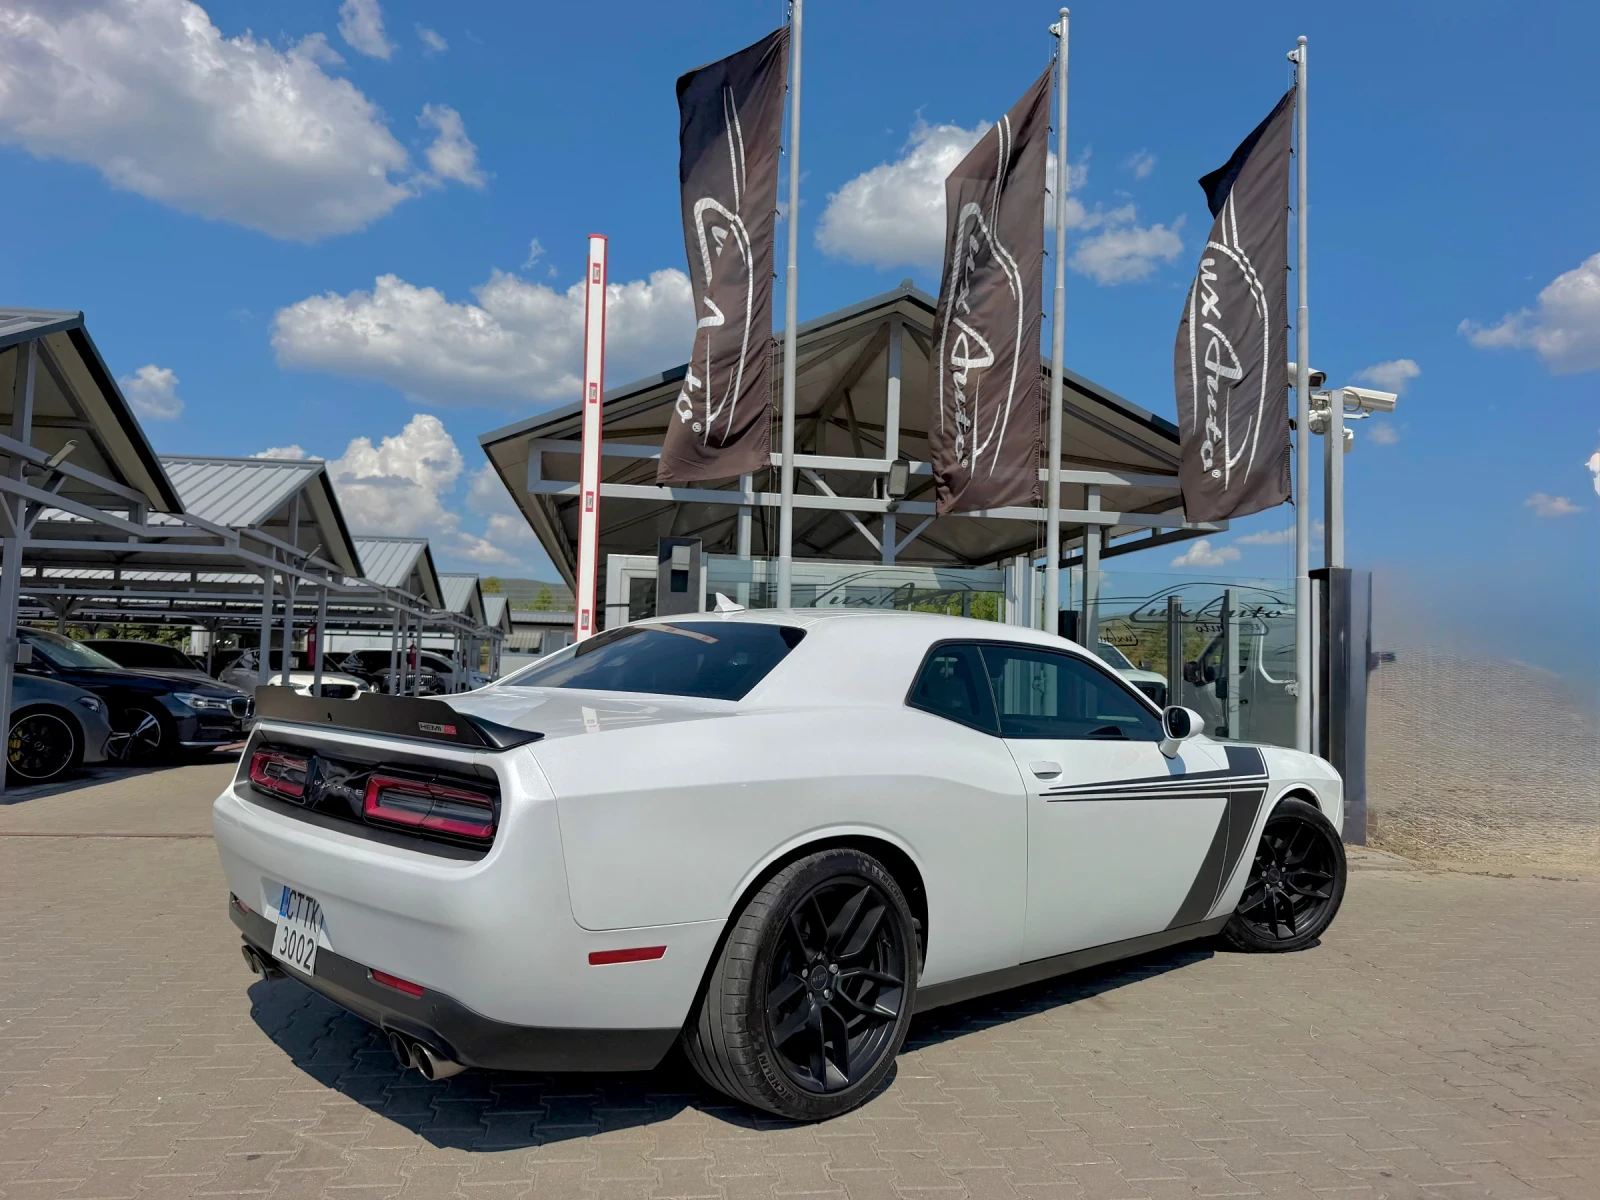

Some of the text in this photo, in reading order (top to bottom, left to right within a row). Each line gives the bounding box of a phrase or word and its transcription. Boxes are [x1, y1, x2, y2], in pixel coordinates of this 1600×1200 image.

[419, 723, 443, 732] HEMI
[286, 889, 321, 933] CTTK
[279, 925, 315, 970] 3002
